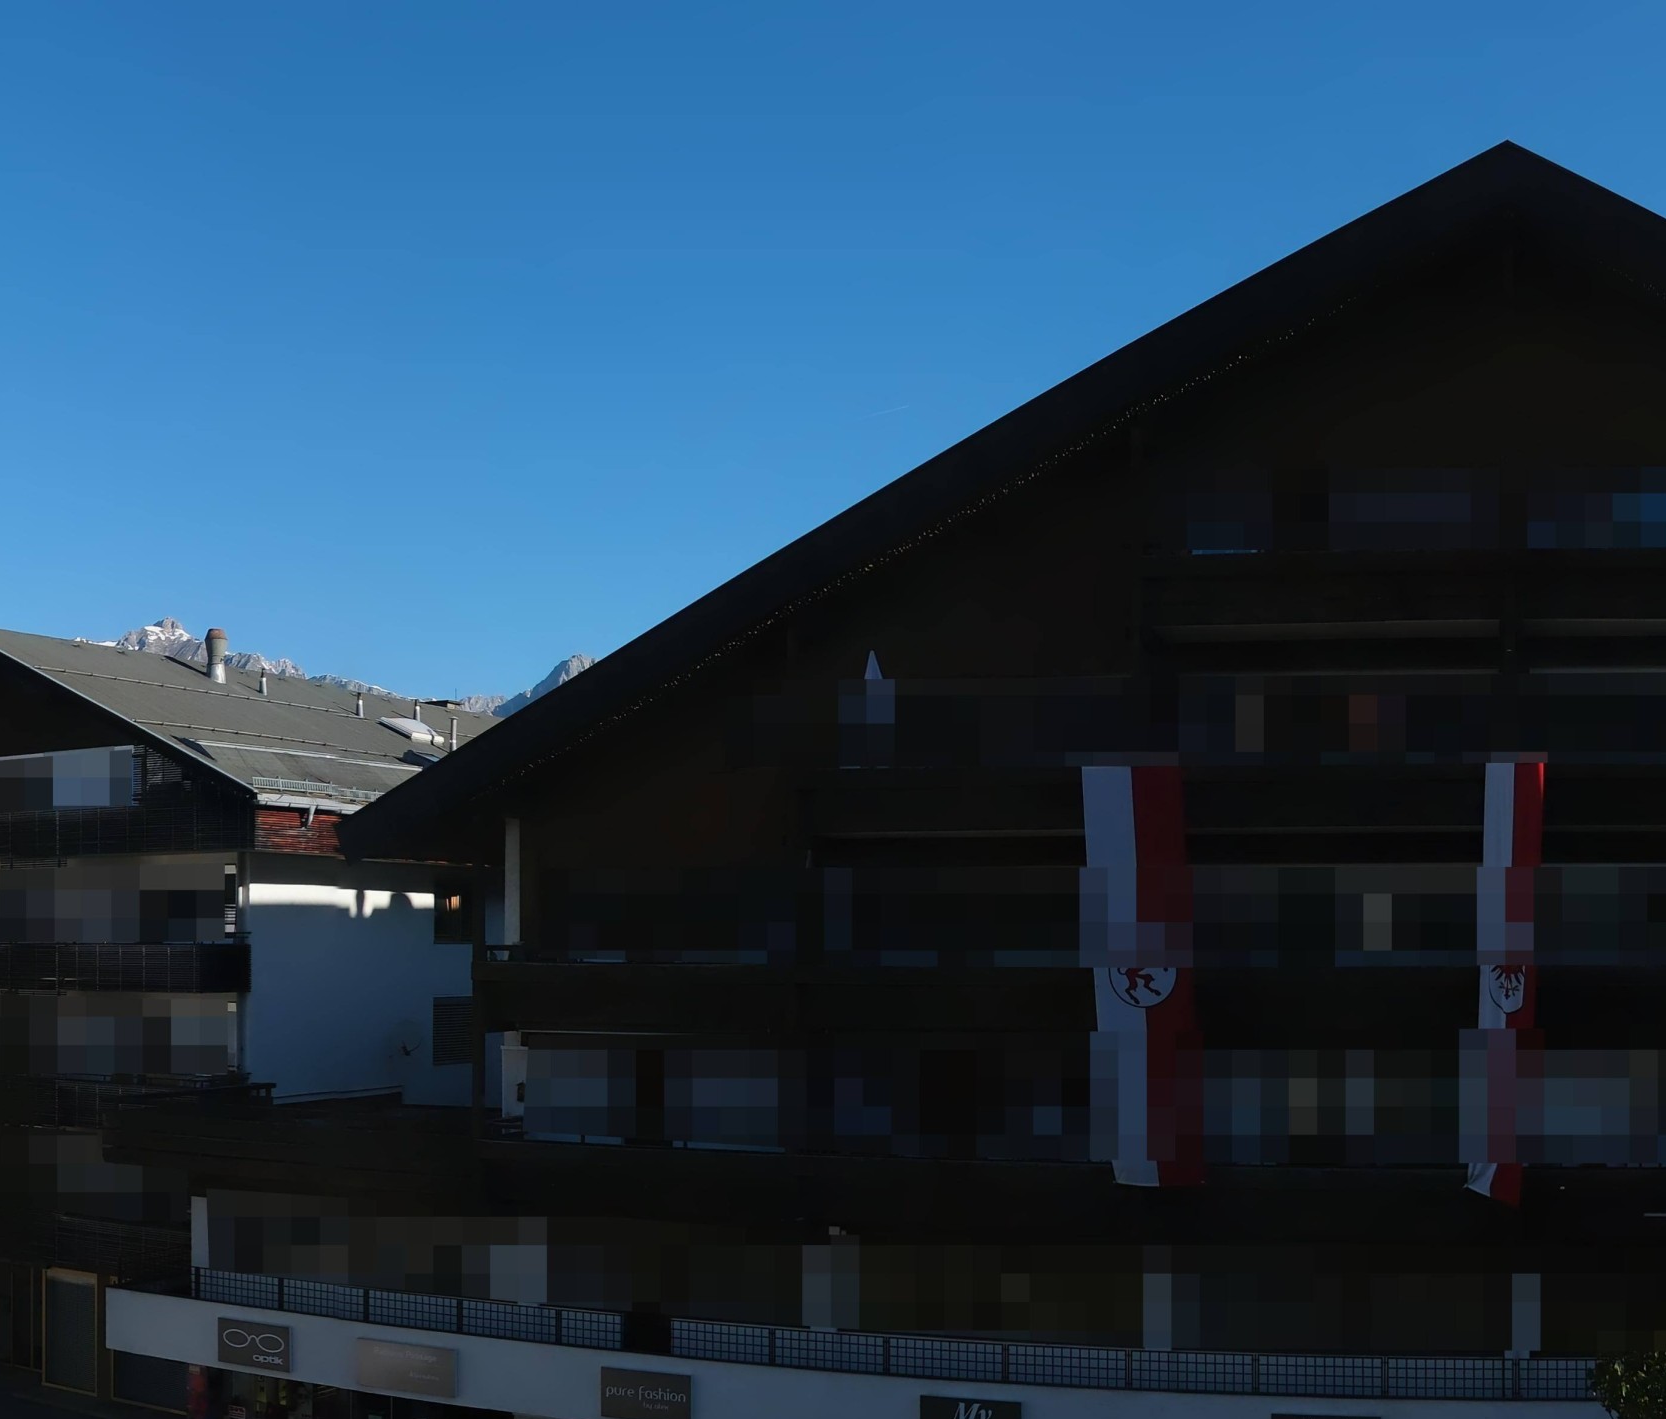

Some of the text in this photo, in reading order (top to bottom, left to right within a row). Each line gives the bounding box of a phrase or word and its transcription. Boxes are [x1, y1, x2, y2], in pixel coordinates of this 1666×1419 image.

[252, 1354, 283, 1365] optik
[606, 1385, 686, 1402] pure fashion
